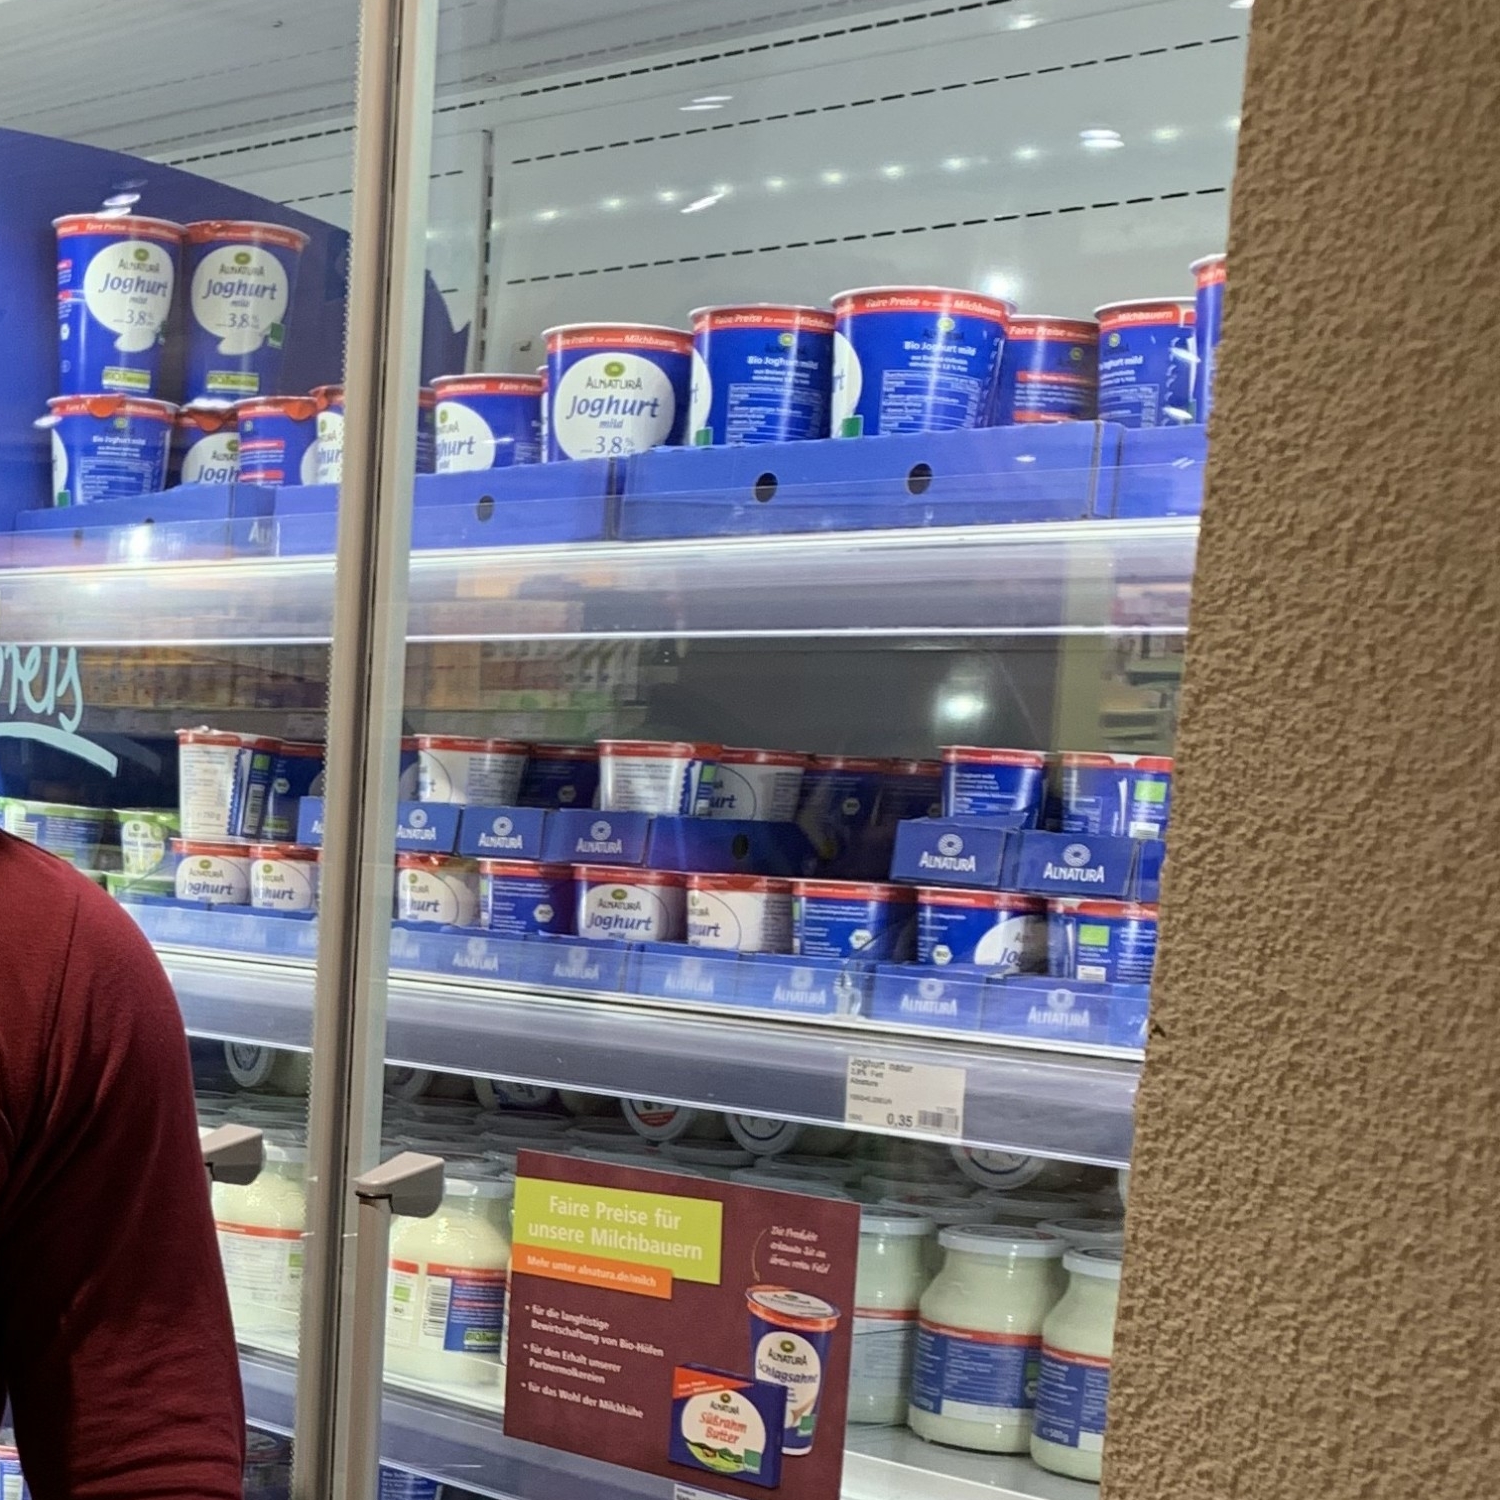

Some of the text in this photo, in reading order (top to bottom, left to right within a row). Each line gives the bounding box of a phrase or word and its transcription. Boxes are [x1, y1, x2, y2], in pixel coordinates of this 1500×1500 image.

[100, 272, 168, 299] Joghurt
[203, 279, 277, 300] Joghurt
[586, 377, 643, 391] ALNATURA
[566, 395, 660, 420] Joghurt
[198, 463, 239, 484] Jogh
[478, 832, 523, 849] ALNATURA
[576, 838, 623, 854] ALNATURA
[918, 851, 976, 872] ALNATURA
[1043, 863, 1105, 883] ALNATURA
[598, 898, 642, 911] ALNATURA
[587, 912, 652, 931] Joghurt
[901, 994, 957, 1016] ALNATURA
[1028, 1006, 1090, 1027] ALNATURA
[851, 1058, 886, 1070] Joghurt
[550, 1195, 682, 1230] Faire Preise für
[529, 1222, 702, 1261] unsere Milchbauern
[527, 1255, 657, 1288] Mehr unter alnatura.de/milch
[531, 1304, 544, 1315] für
[531, 1319, 664, 1357] Bewirtschaftung von Bio-Höfen
[530, 1343, 622, 1372] für den Erhalt unserer
[767, 1348, 808, 1366] ALNATURA
[529, 1357, 605, 1385] Partnermolkereien
[528, 1382, 541, 1393] für
[558, 1389, 581, 1403] Wohl
[699, 1412, 747, 1433] Süßrahm
[705, 1427, 740, 1445] Butter
